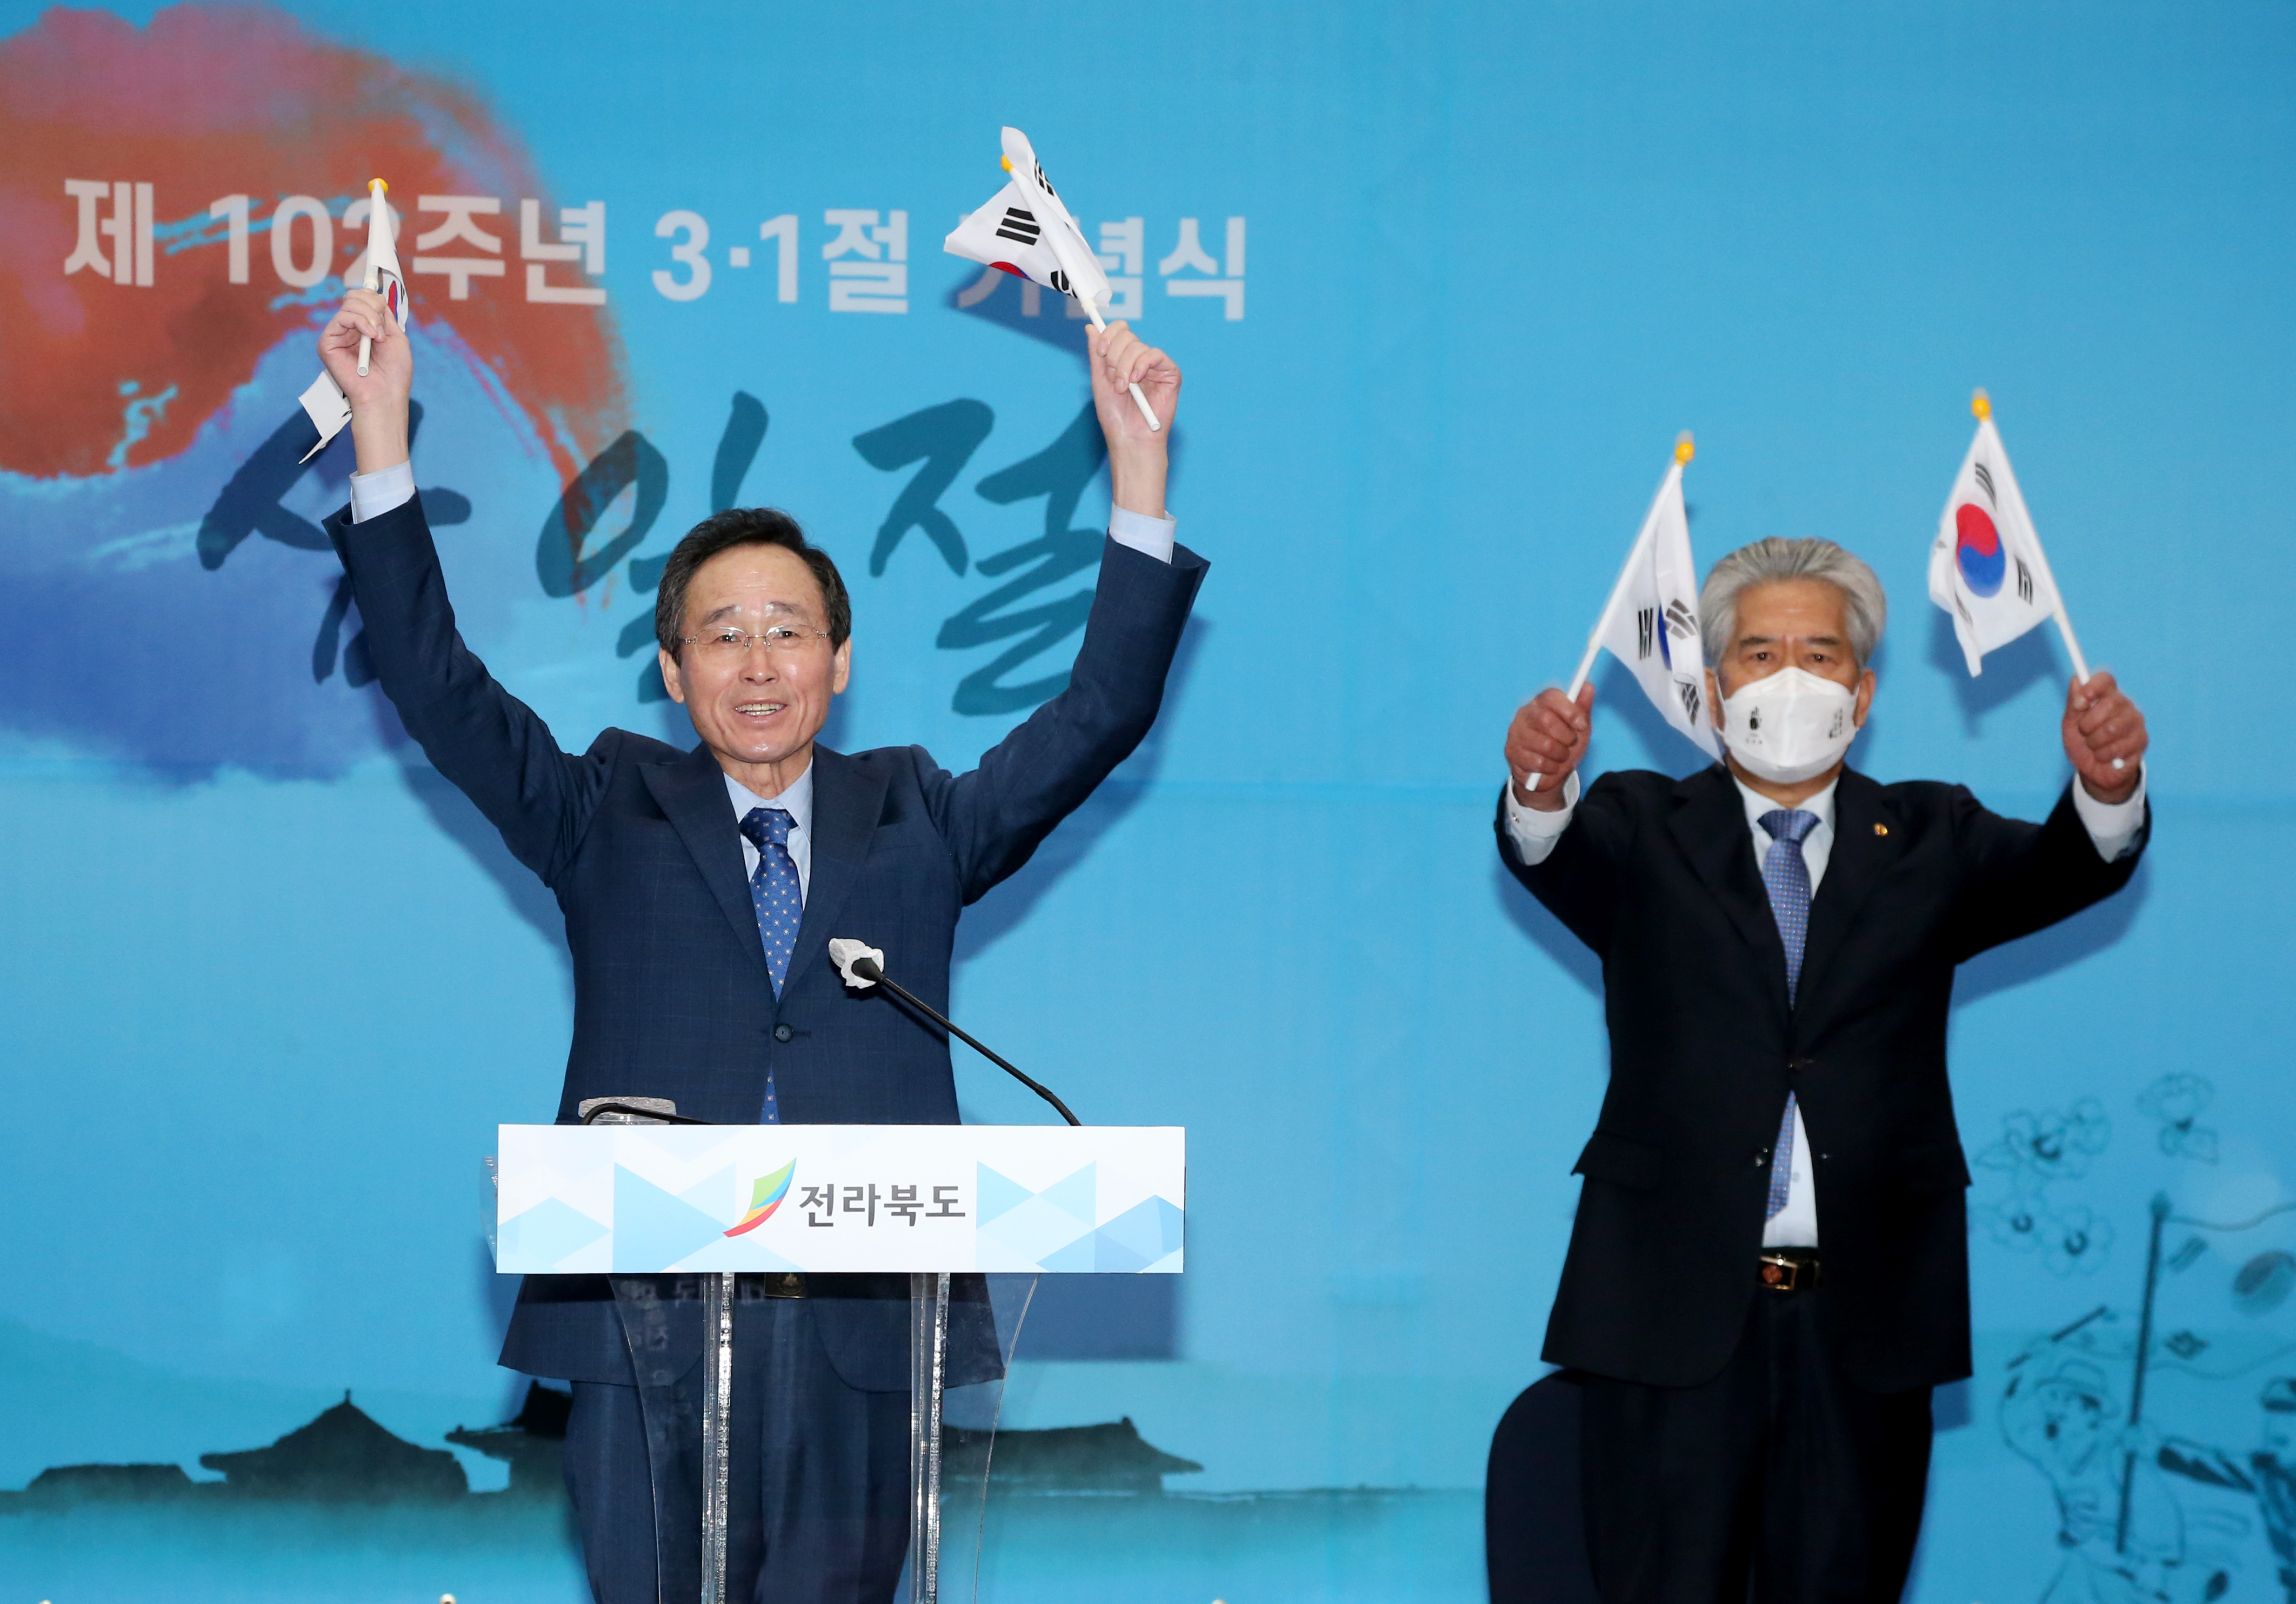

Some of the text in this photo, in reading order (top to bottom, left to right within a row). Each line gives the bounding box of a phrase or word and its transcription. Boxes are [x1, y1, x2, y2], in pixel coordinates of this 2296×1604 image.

[64, 178, 154, 287] 제
[651, 208, 909, 315] 3·1절
[798, 1183, 966, 1227] 전라북도
